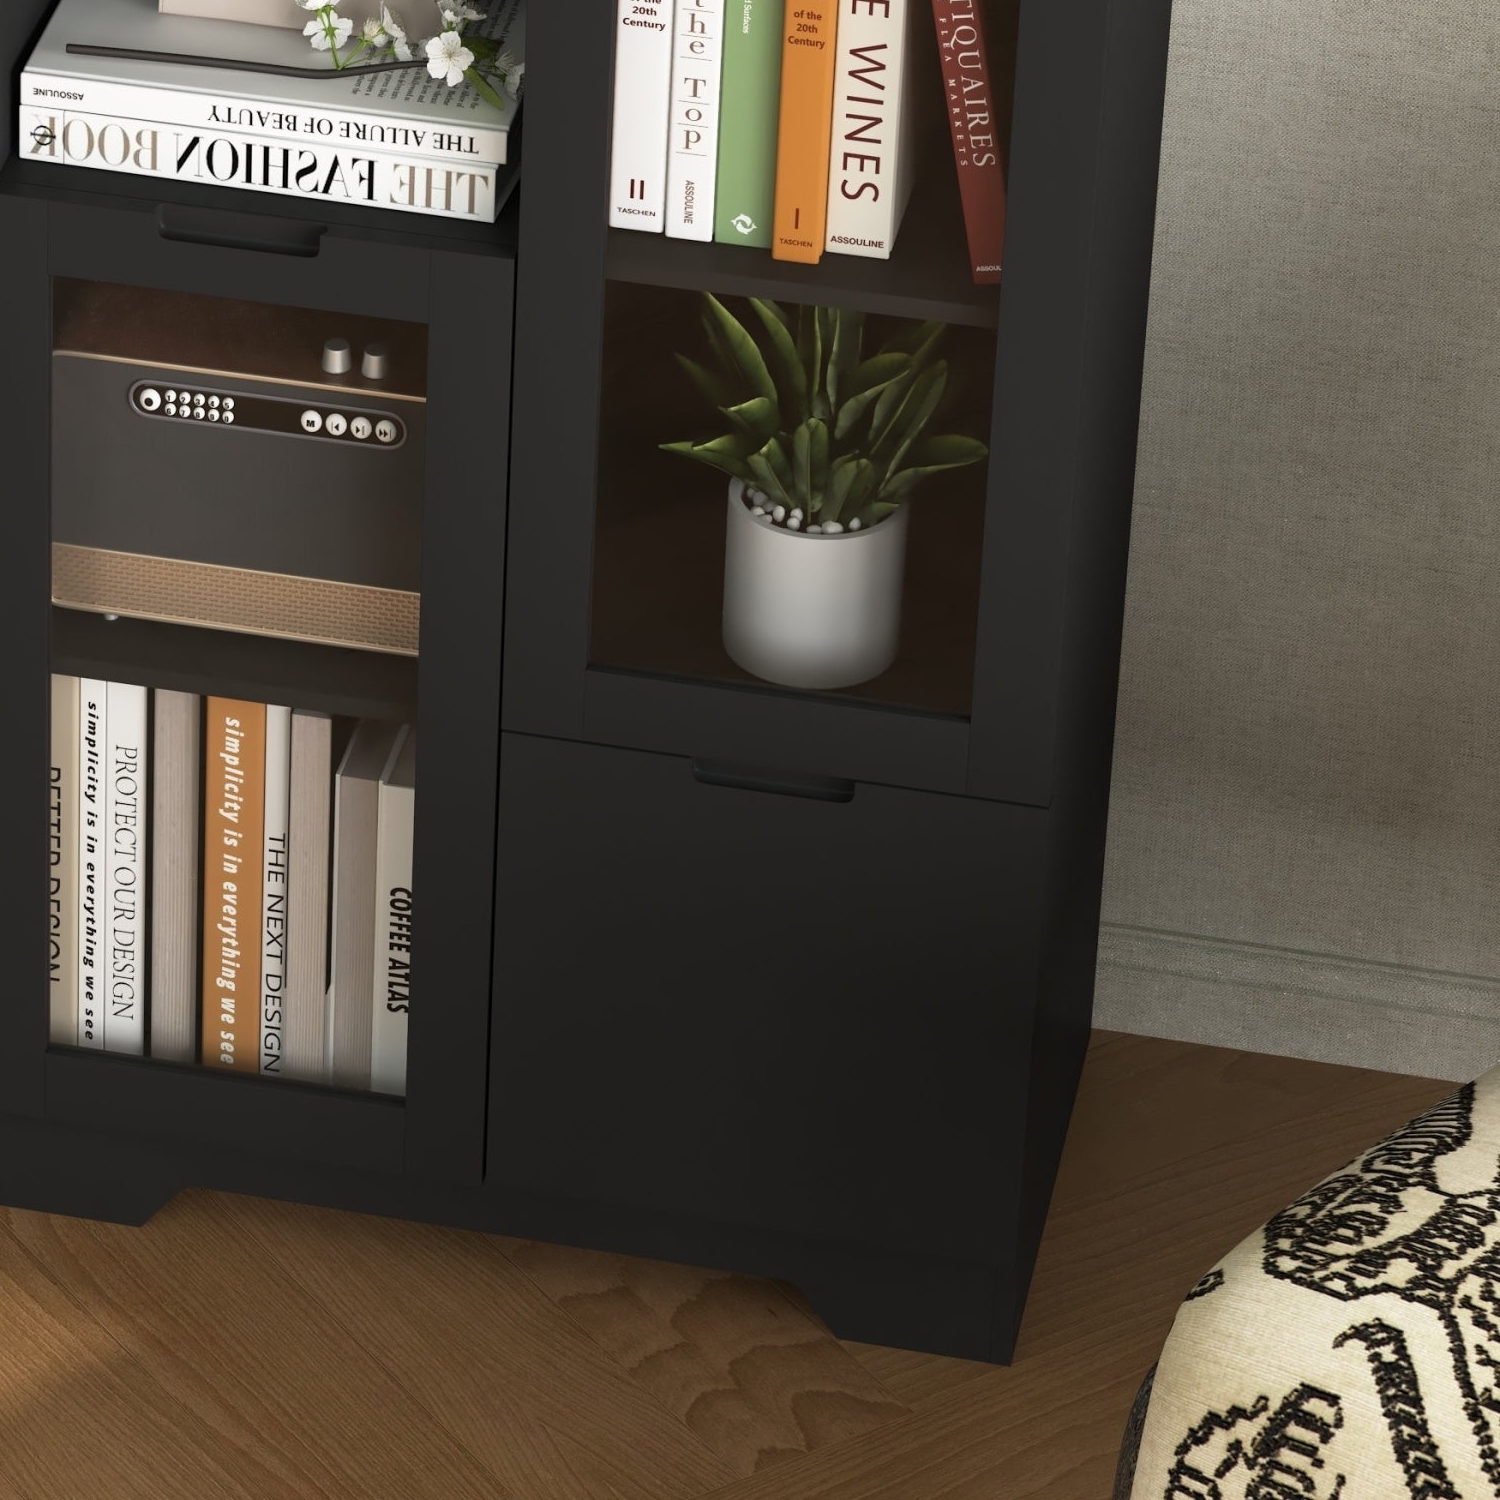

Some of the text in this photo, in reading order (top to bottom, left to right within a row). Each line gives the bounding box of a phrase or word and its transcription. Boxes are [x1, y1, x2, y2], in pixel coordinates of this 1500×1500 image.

[631, 5, 658, 18] 20th
[742, 4, 753, 34] Surfaces
[793, 9, 822, 21] of the
[622, 16, 666, 32] Century
[796, 23, 818, 34] 20th
[787, 35, 826, 50] Century
[33, 87, 84, 101] ASSOULINE
[939, 17, 952, 62] FLEA
[948, 79, 969, 166] MARKETS
[207, 104, 479, 155] THE ALLURE OF BEAUTY
[840, 42, 889, 204] WINES
[616, 206, 657, 218] TASCHEN
[683, 180, 695, 225] ASSOULINE
[779, 237, 814, 249] TASCHEN
[830, 234, 885, 250] ASSOULINE
[306, 419, 315, 428] M
[82, 701, 99, 1040] simplicity is in everything we see
[112, 744, 138, 1021] PROTECT OUR DESIGN
[215, 716, 245, 1065] simplicity is in everything we see
[263, 832, 286, 1073] THE NEXT DESIGN
[386, 886, 412, 1015] COFFEE ATLAS
